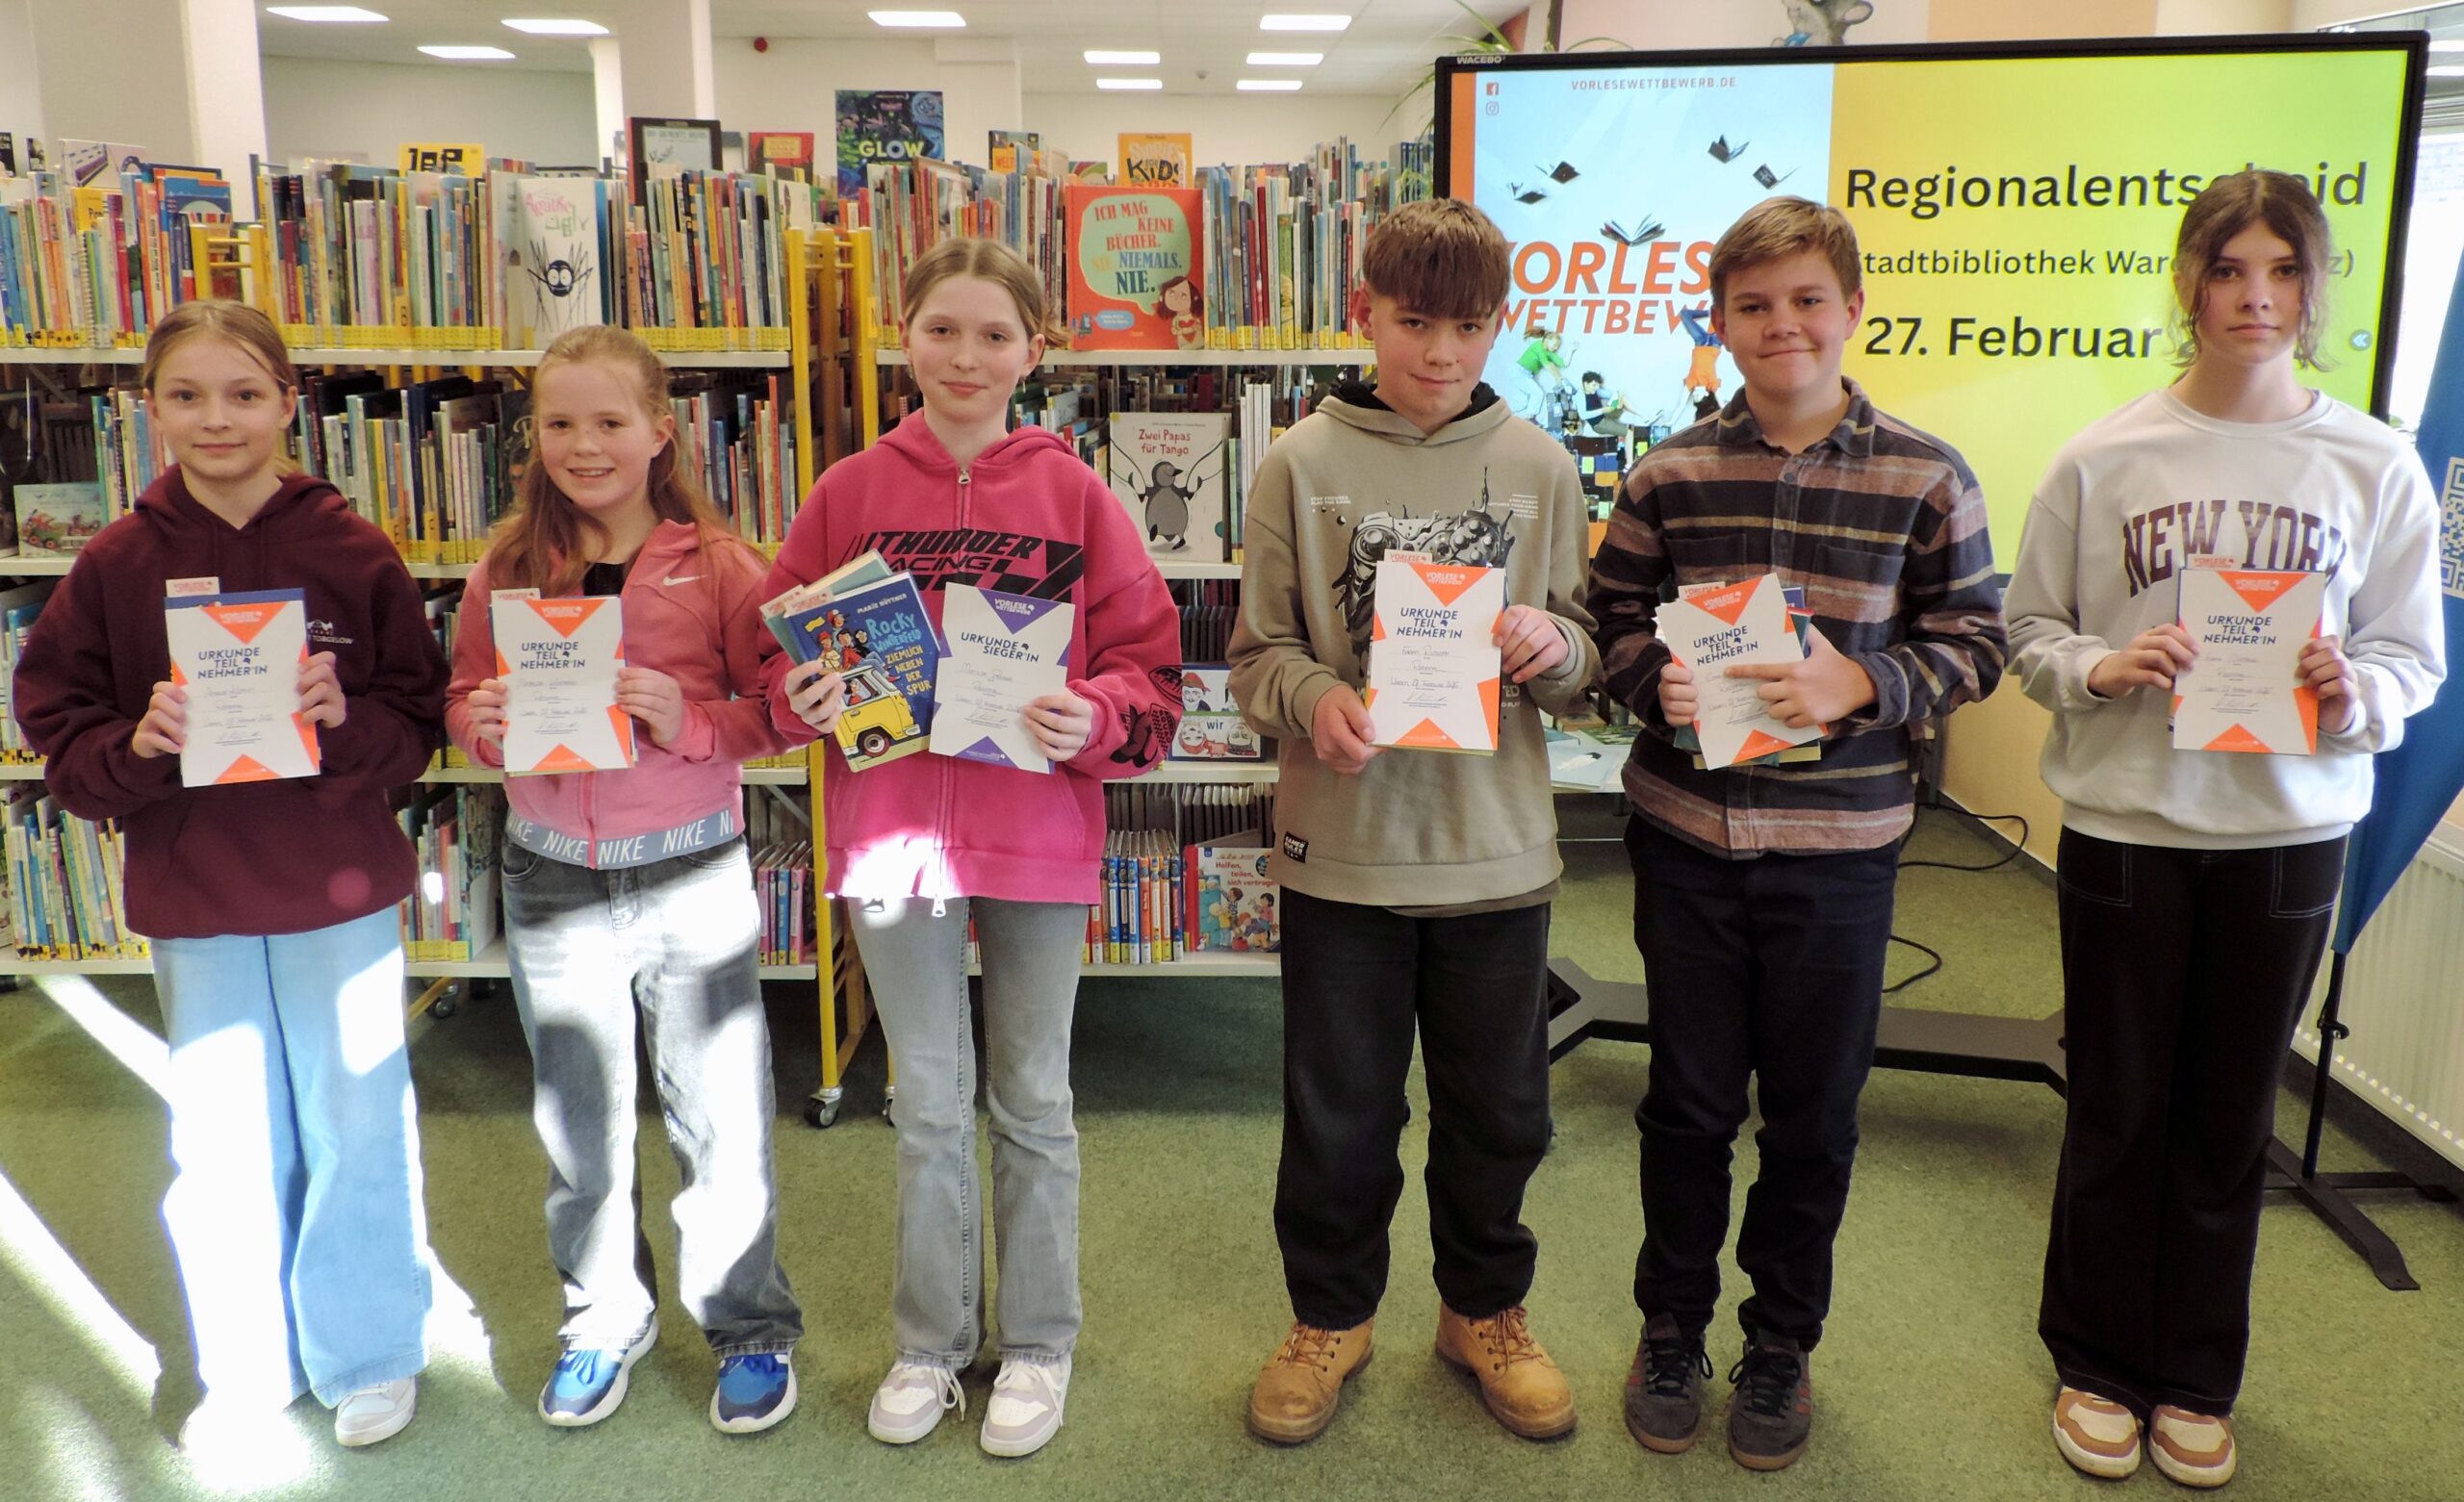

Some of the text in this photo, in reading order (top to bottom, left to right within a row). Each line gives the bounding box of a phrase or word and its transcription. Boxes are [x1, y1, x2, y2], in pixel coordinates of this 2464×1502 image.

[1571, 77, 1736, 90] VORLESEWETTBEWERB.DE
[859, 140, 924, 159] GLOW
[1846, 161, 2368, 220] Regionalentsid
[1093, 200, 1149, 221] ICH MAG
[1138, 217, 1175, 233] KEINE
[1106, 233, 1162, 252] BÜCHER.
[1118, 251, 1183, 269] NIEMALS.
[1859, 249, 2096, 275] tadtbibliothek
[1116, 269, 1156, 295] NIE.
[1865, 317, 1928, 356] 27.
[1948, 315, 2163, 358] Februar
[1139, 428, 1192, 444] Zwei Papas
[1142, 444, 1190, 457] für Tango
[877, 527, 1043, 559] THUNDER
[2122, 499, 2227, 598] NEW
[883, 555, 992, 572] ACING
[1399, 607, 1459, 621] URKUNDE
[1413, 617, 1436, 628] TEIL
[2207, 615, 2272, 626] URKUNDE
[1692, 625, 1749, 649] URKUNDE
[2221, 625, 2247, 635] TEIL
[521, 641, 579, 651] URKUNDE
[961, 631, 1019, 650] URKUNDE
[1707, 641, 1732, 653] TEIL
[197, 647, 261, 661] URKUNDE
[535, 650, 558, 660] TEIL
[214, 659, 239, 670] TEIL
[894, 657, 924, 674] NEBEN
[906, 670, 923, 683] DER
[906, 679, 933, 697] SPUR
[1206, 719, 1224, 730] wir
[662, 819, 706, 854] NIKE
[543, 829, 589, 862] NIKE
[597, 835, 647, 865] NIKE
